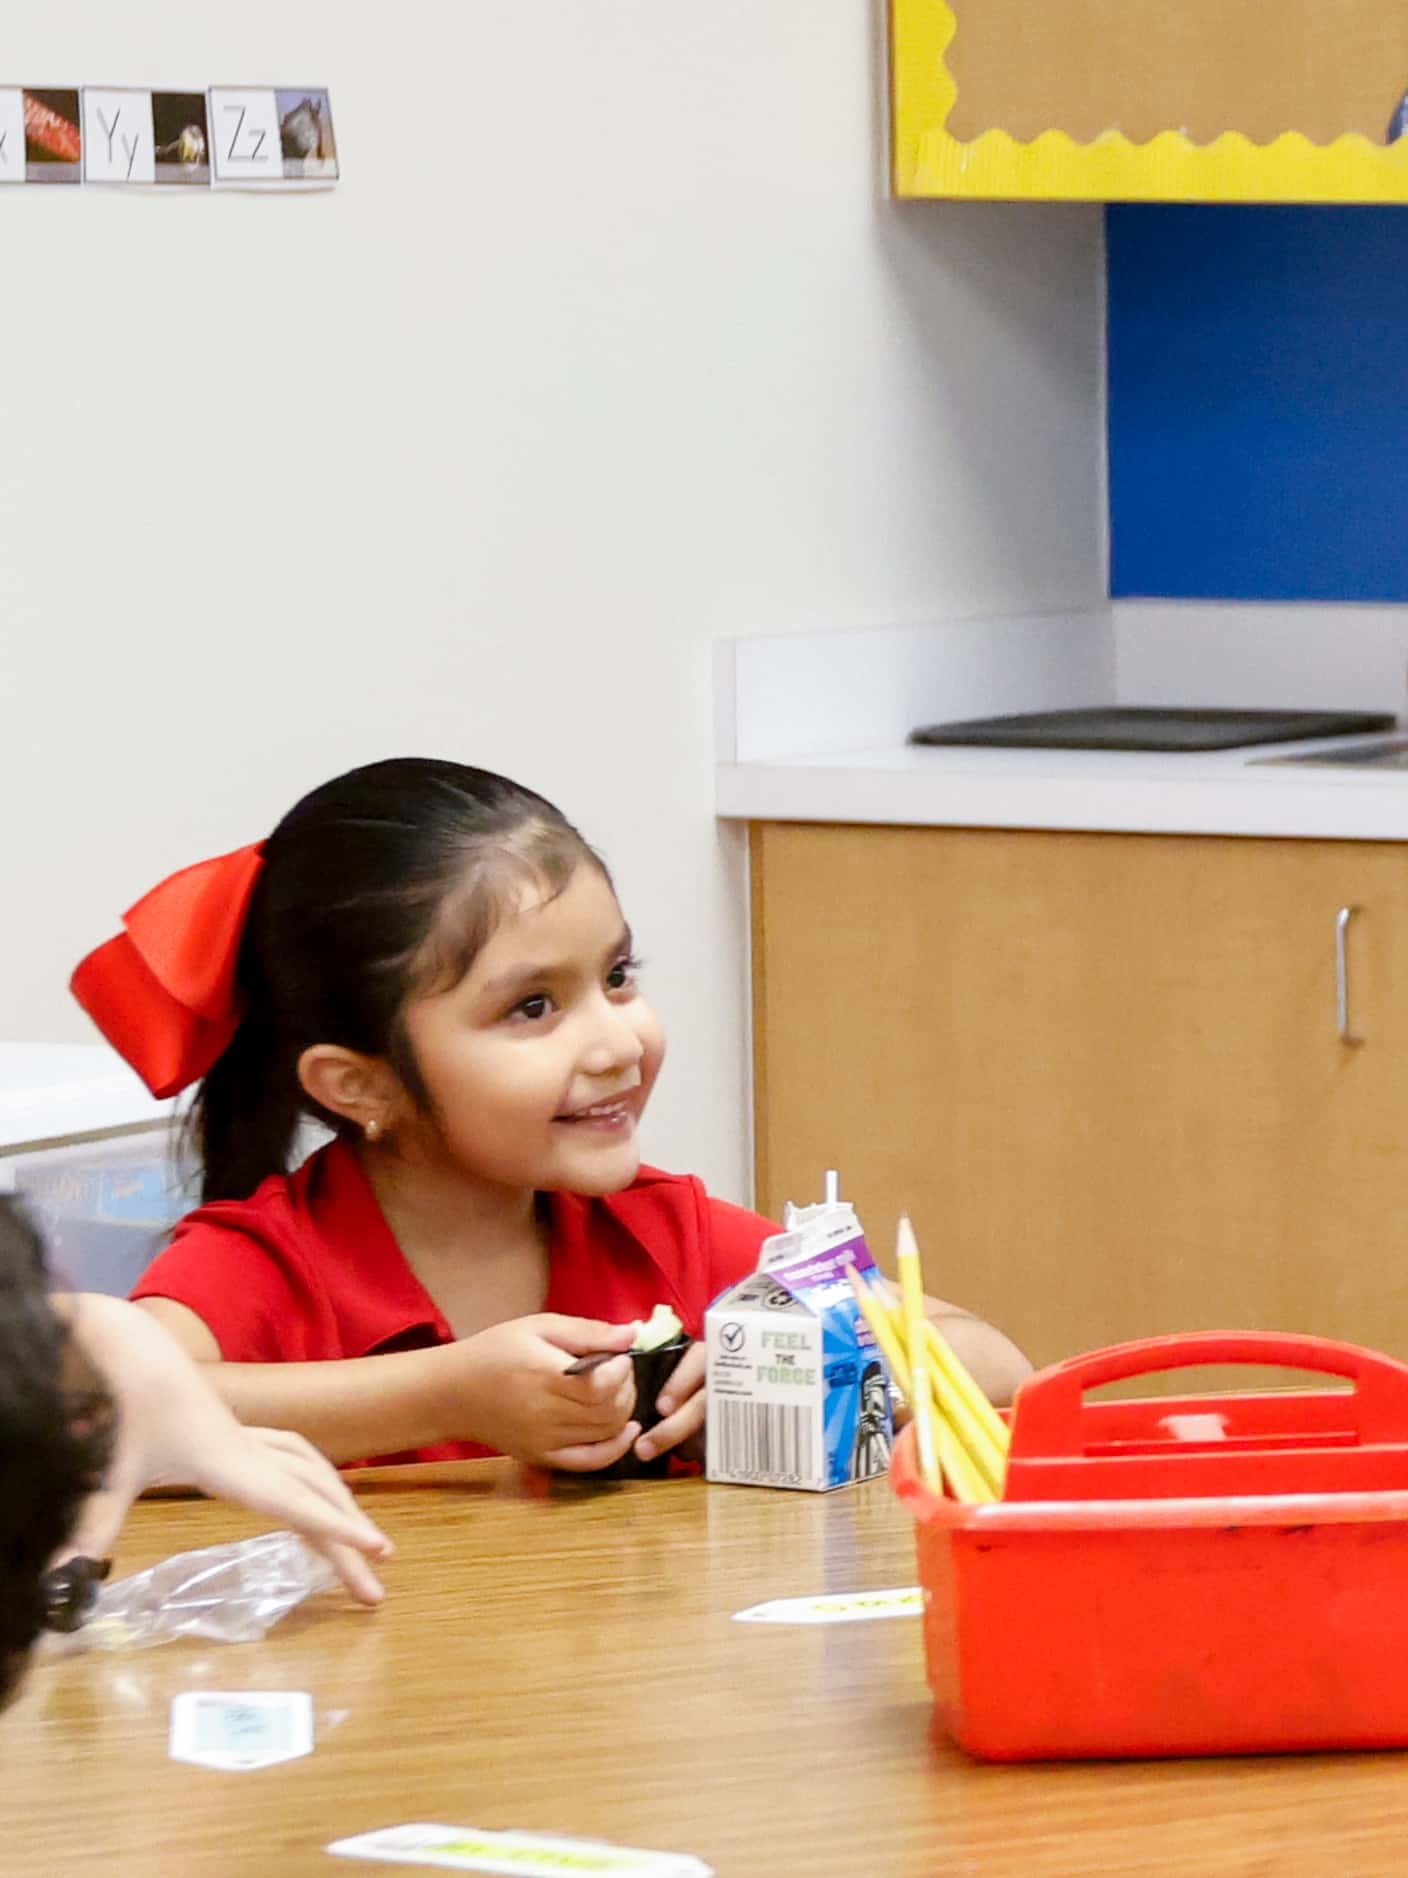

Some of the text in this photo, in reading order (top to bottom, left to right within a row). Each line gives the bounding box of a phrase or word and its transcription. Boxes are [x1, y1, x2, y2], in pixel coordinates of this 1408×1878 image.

[761, 1330, 812, 1351] FEEL
[775, 1353, 796, 1366] THE
[756, 1365, 817, 1386] FORCE
